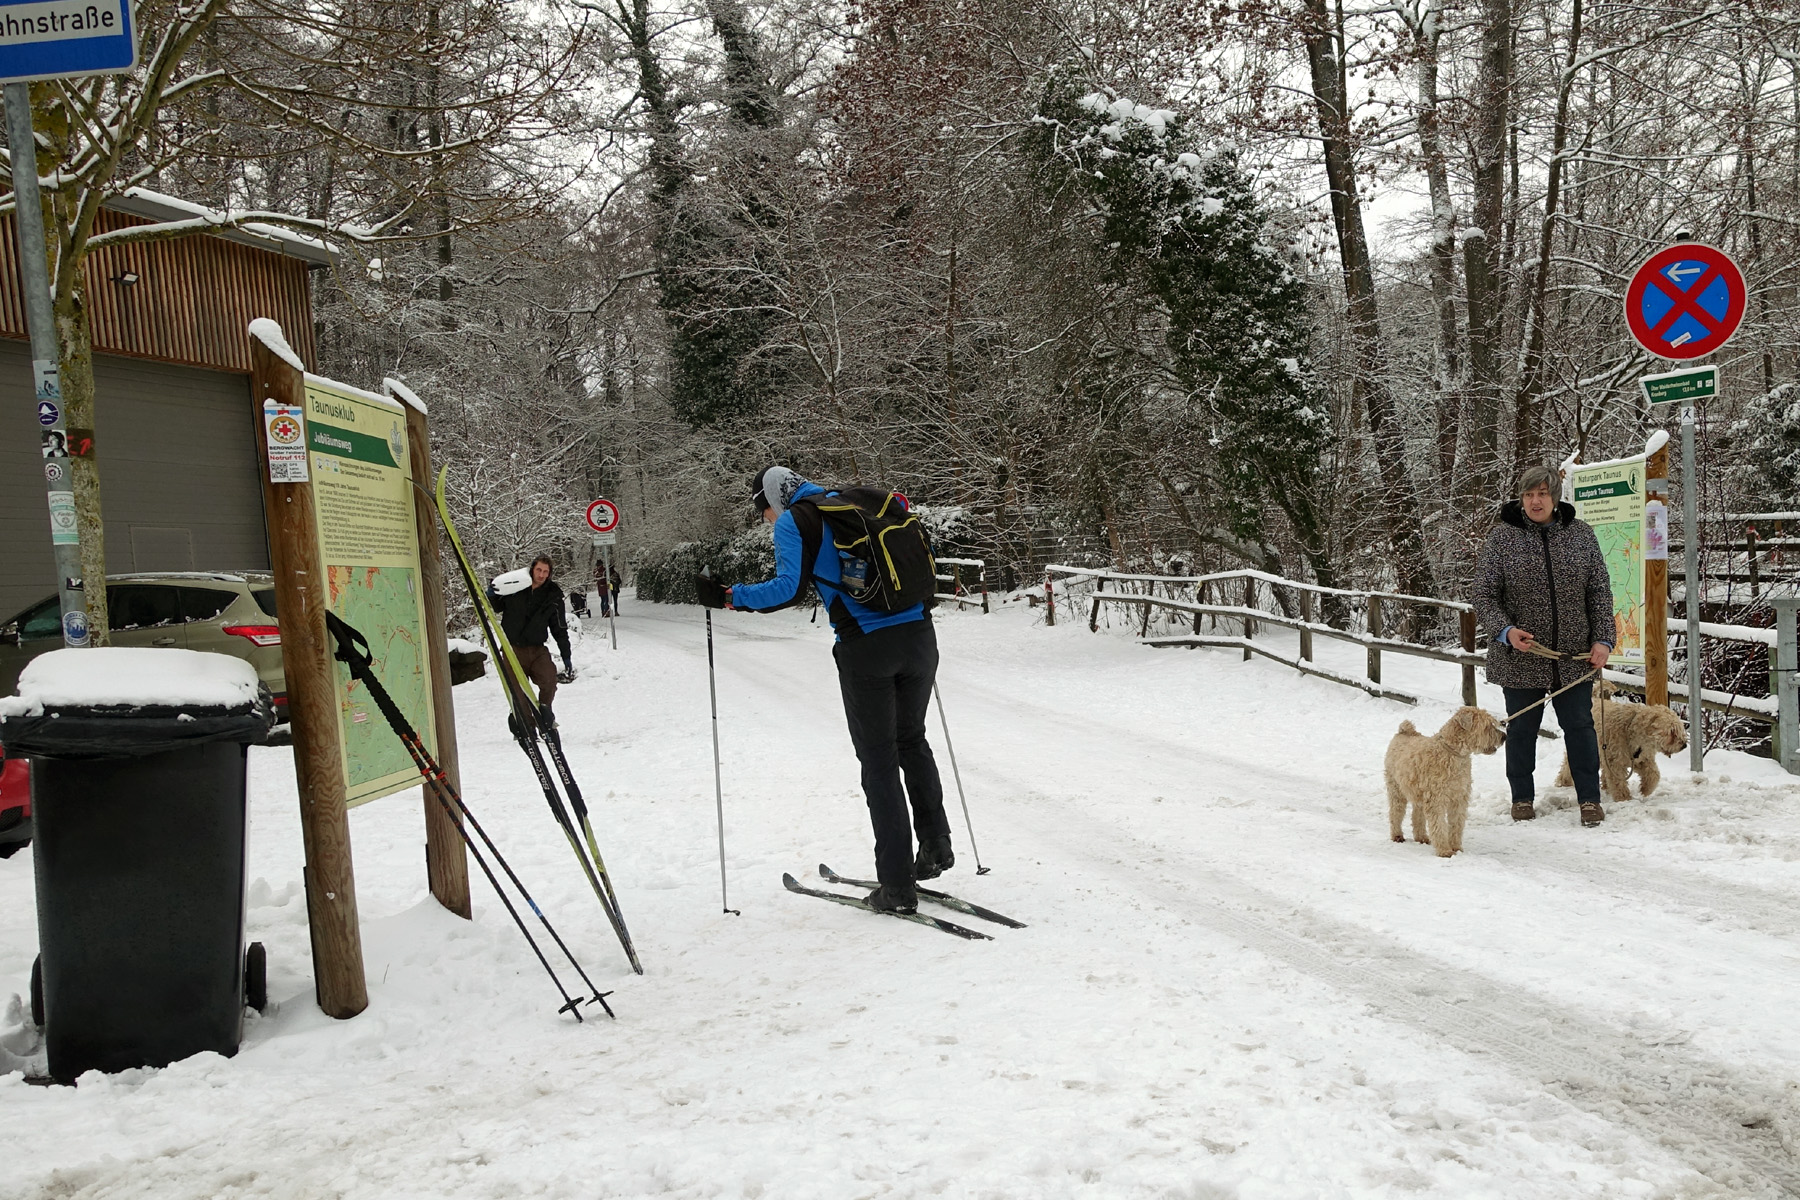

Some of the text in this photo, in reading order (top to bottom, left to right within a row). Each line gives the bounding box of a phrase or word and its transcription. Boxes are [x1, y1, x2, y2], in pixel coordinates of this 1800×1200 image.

[309, 395, 355, 422] Taunusklub
[313, 431, 352, 453] Jubiläumsweg
[1578, 470, 1622, 483] Naturpark Taunus
[1598, 487, 1614, 495] Taunus
